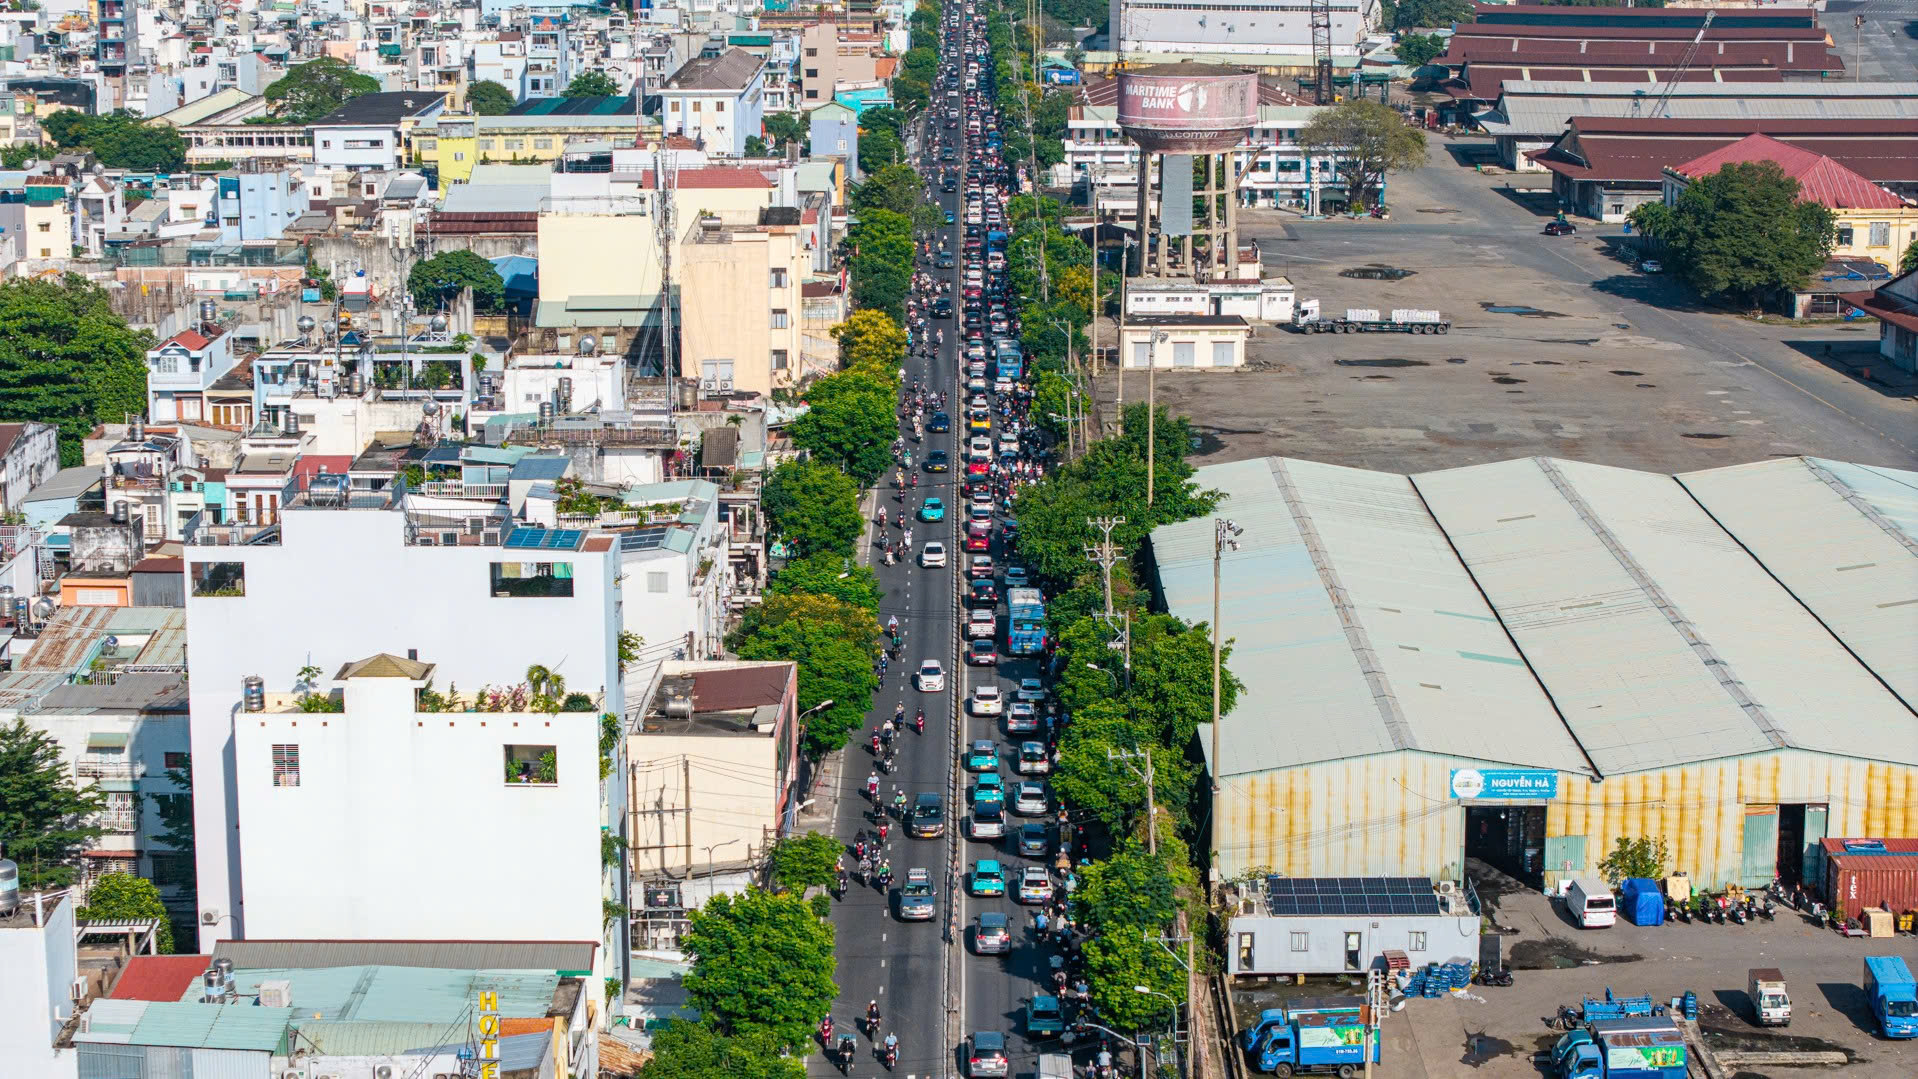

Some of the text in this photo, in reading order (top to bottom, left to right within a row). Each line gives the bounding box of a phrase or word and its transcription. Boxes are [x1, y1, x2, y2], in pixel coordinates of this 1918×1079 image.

[1125, 84, 1178, 98] MARITIME
[1141, 97, 1177, 109] BANK
[1534, 777, 1550, 788] HÀ
[1849, 875, 1857, 900] tex
